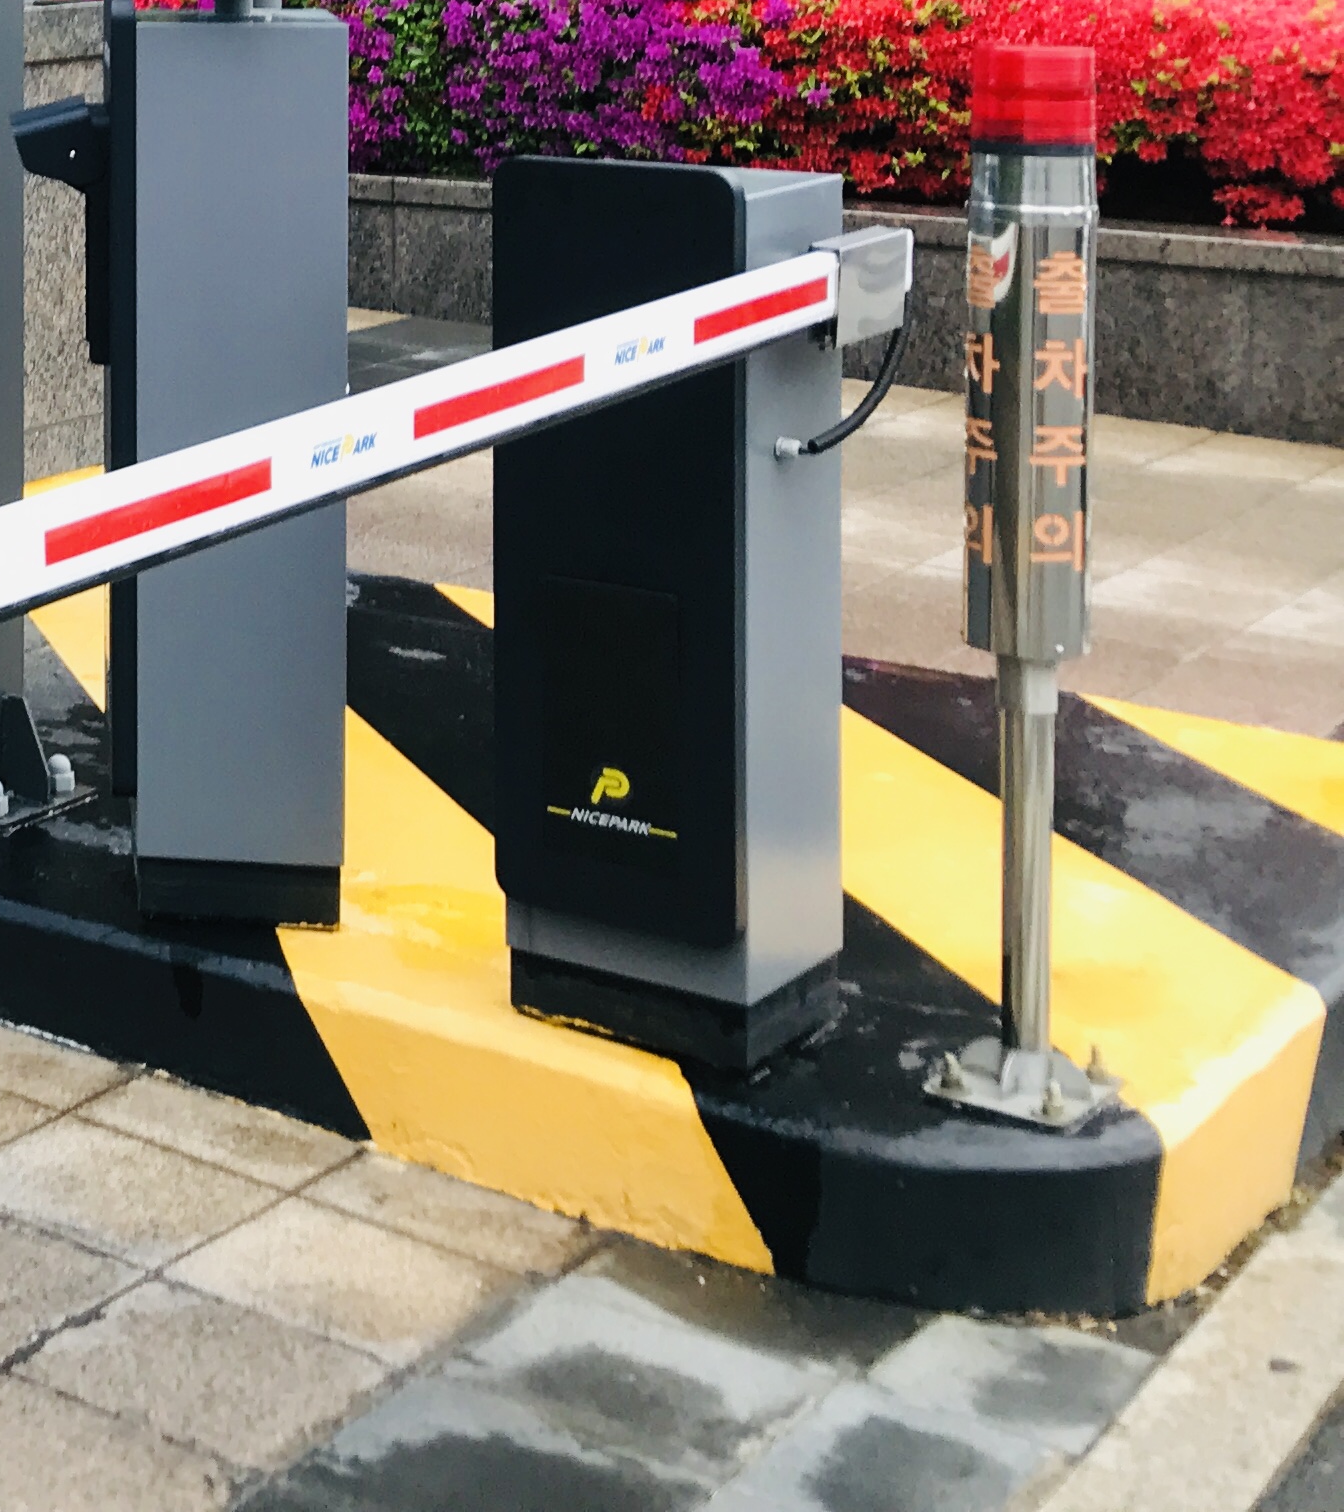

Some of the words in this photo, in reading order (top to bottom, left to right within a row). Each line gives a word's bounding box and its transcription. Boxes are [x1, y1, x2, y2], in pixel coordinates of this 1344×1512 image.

[614, 335, 666, 366] NICEPARK
[1029, 250, 1088, 572] 출차주의
[310, 431, 378, 469] NICEPARK
[570, 807, 651, 836] NICEPARK
